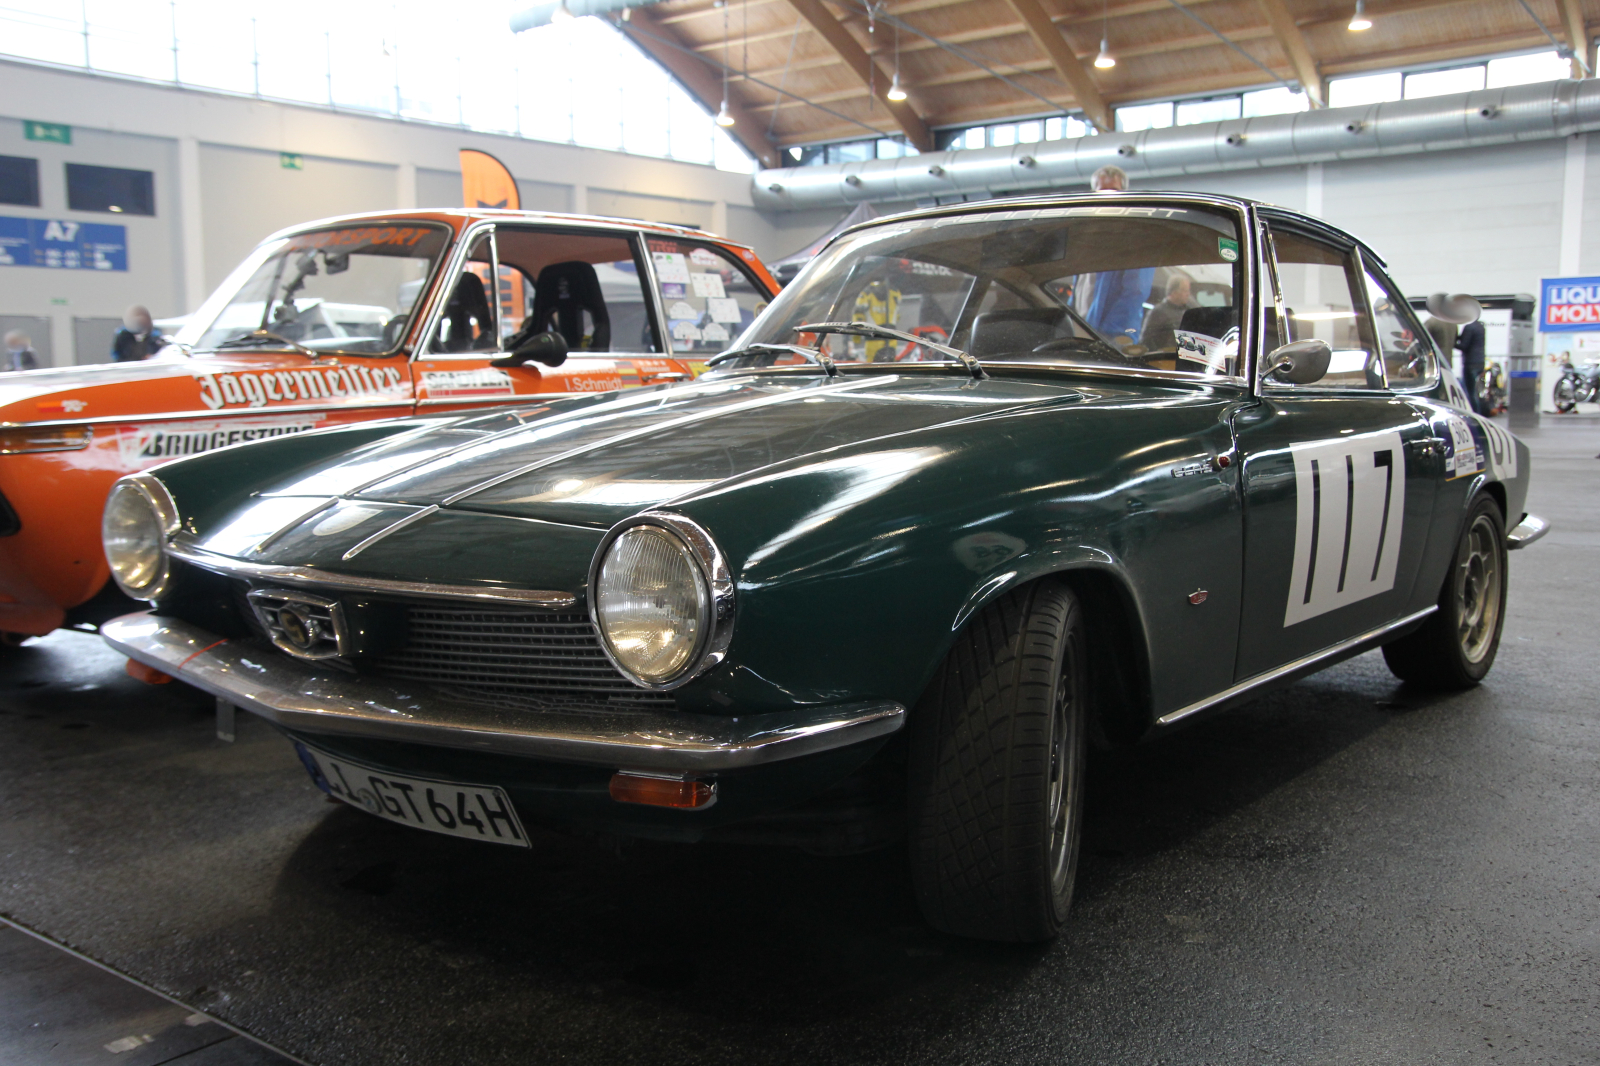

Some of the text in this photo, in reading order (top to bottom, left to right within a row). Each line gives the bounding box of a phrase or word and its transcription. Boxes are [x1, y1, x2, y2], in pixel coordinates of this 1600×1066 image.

[44, 221, 79, 242] A7
[1302, 449, 1393, 605] 117
[368, 776, 424, 823] GT
[427, 787, 522, 840] 64H
